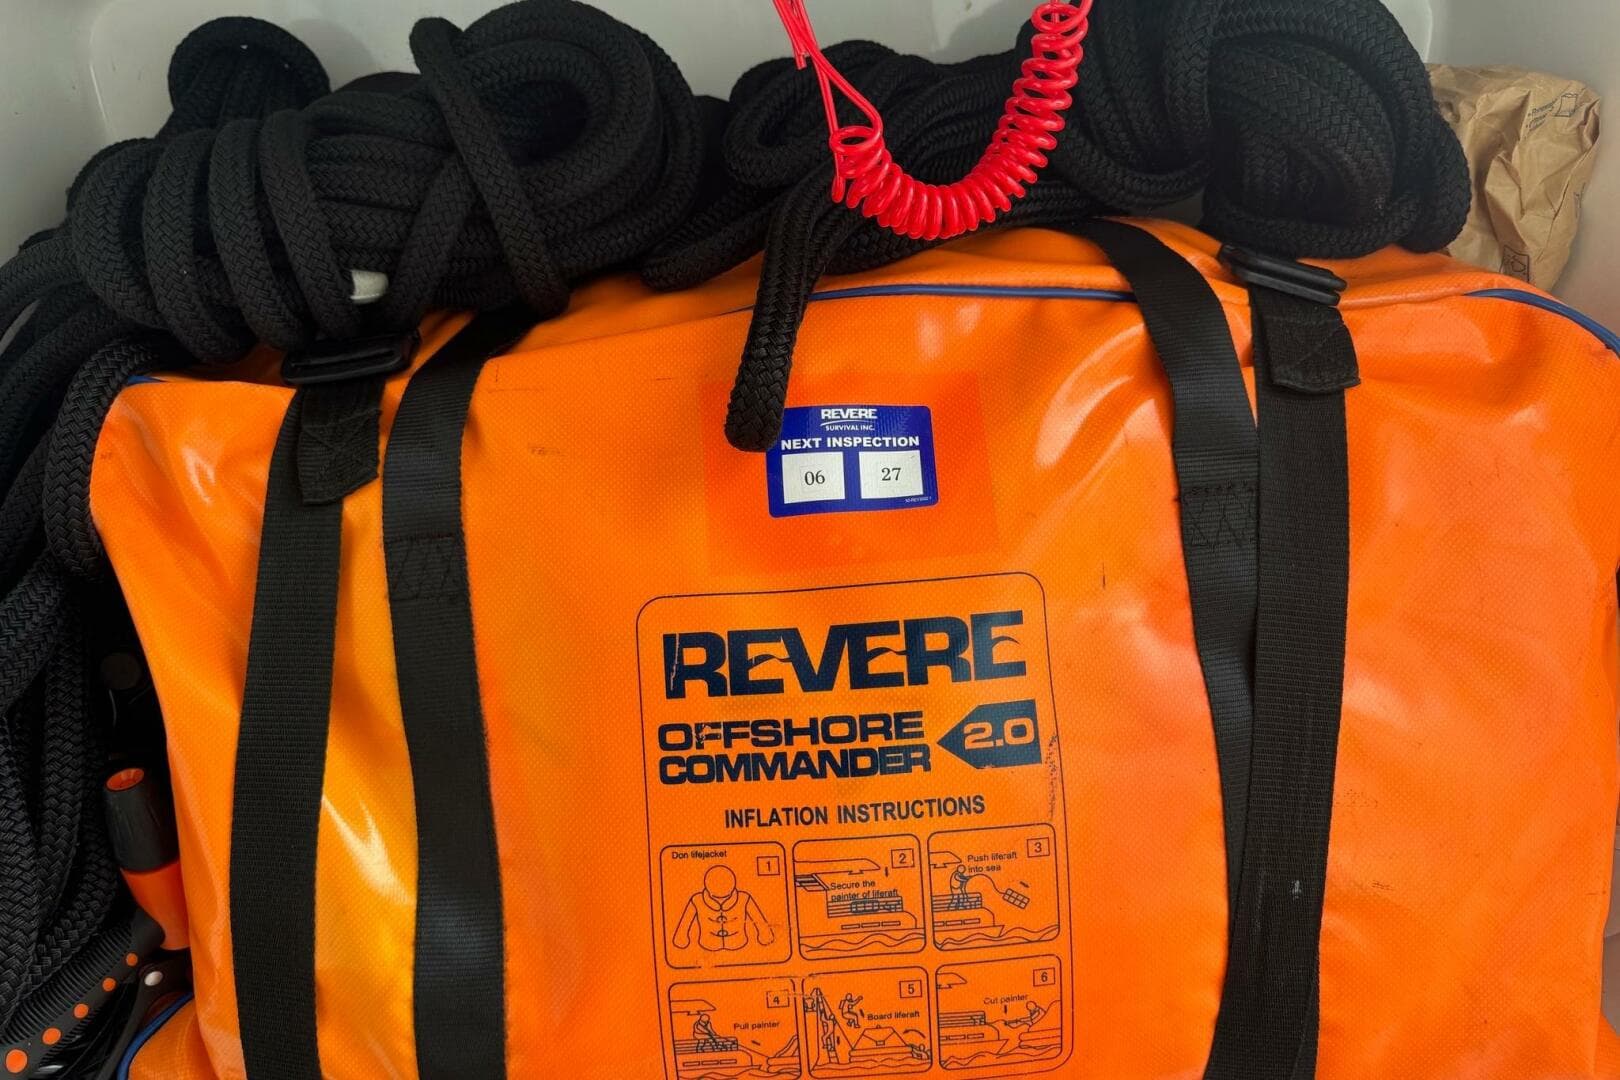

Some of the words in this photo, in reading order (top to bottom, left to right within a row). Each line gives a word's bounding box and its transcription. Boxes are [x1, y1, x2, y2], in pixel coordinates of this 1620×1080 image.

[820, 408, 877, 419] REVERE
[781, 437, 822, 450] NEXT
[826, 436, 920, 448] INSPECTION
[804, 470, 826, 486] 06
[881, 467, 901, 481] 27
[662, 609, 1027, 700] REVERE
[657, 710, 925, 751] OFFSHORE
[963, 717, 1035, 750] 2.0
[659, 743, 932, 785] COMMANDER
[724, 805, 829, 828] INFLATION
[837, 794, 986, 824] INSTRUCTIONS
[1034, 842, 1042, 853] 3
[671, 851, 689, 860] Don
[690, 849, 728, 860] lifejacket
[899, 852, 906, 864] 2
[967, 854, 989, 862] Push
[991, 851, 1018, 861] liferaft
[968, 865, 984, 873] into
[830, 881, 860, 890] Secure
[862, 880, 876, 888] the
[831, 892, 860, 902] painter
[862, 890, 870, 899] of
[872, 888, 899, 898] liferaft
[1041, 971, 1048, 982] 6
[908, 983, 915, 994] 5
[773, 996, 779, 1005] 4
[984, 997, 998, 1005] Cut
[1001, 994, 1028, 1004] painter
[867, 1012, 893, 1021] Board
[895, 1010, 920, 1019] liferaft
[733, 1022, 750, 1031] Pull
[751, 1020, 780, 1031] painter
